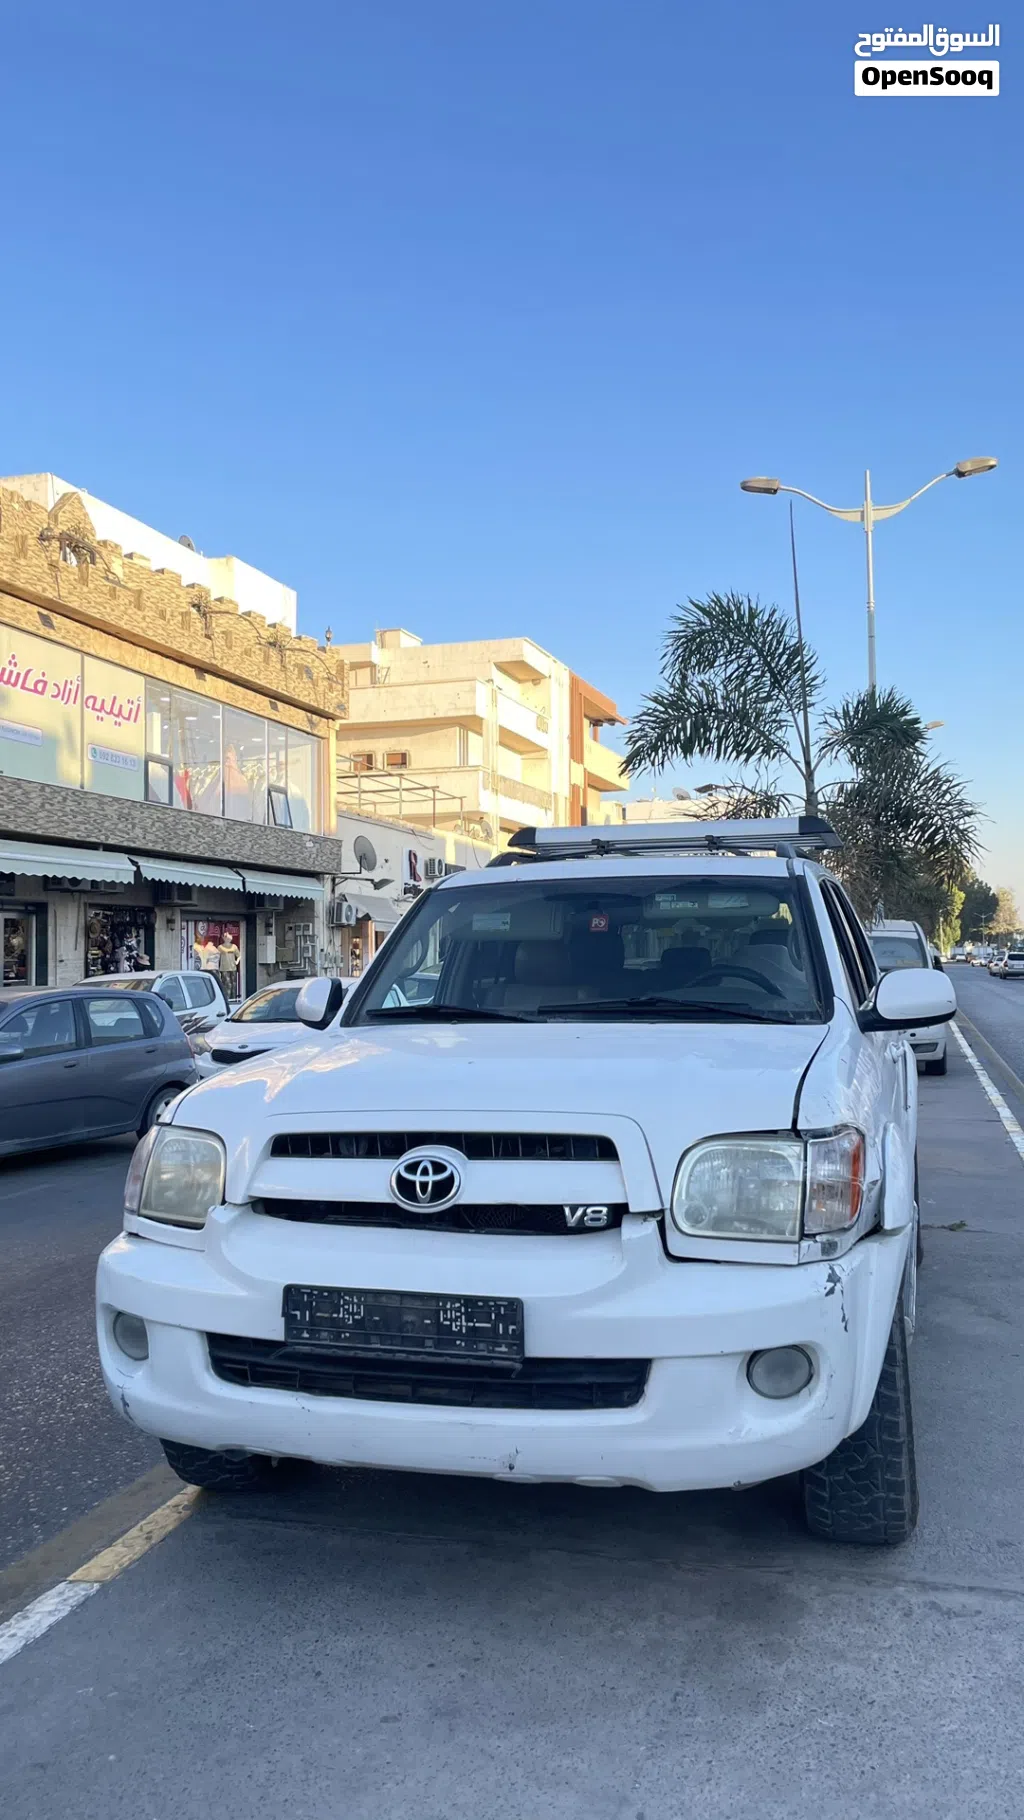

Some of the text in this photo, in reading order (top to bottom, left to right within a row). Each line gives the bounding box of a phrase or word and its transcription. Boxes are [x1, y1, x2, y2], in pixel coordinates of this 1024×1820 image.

[0, 653, 142, 727] أتيليه أزاد فاش
[408, 849, 422, 882] R
[562, 1205, 609, 1227] V8
